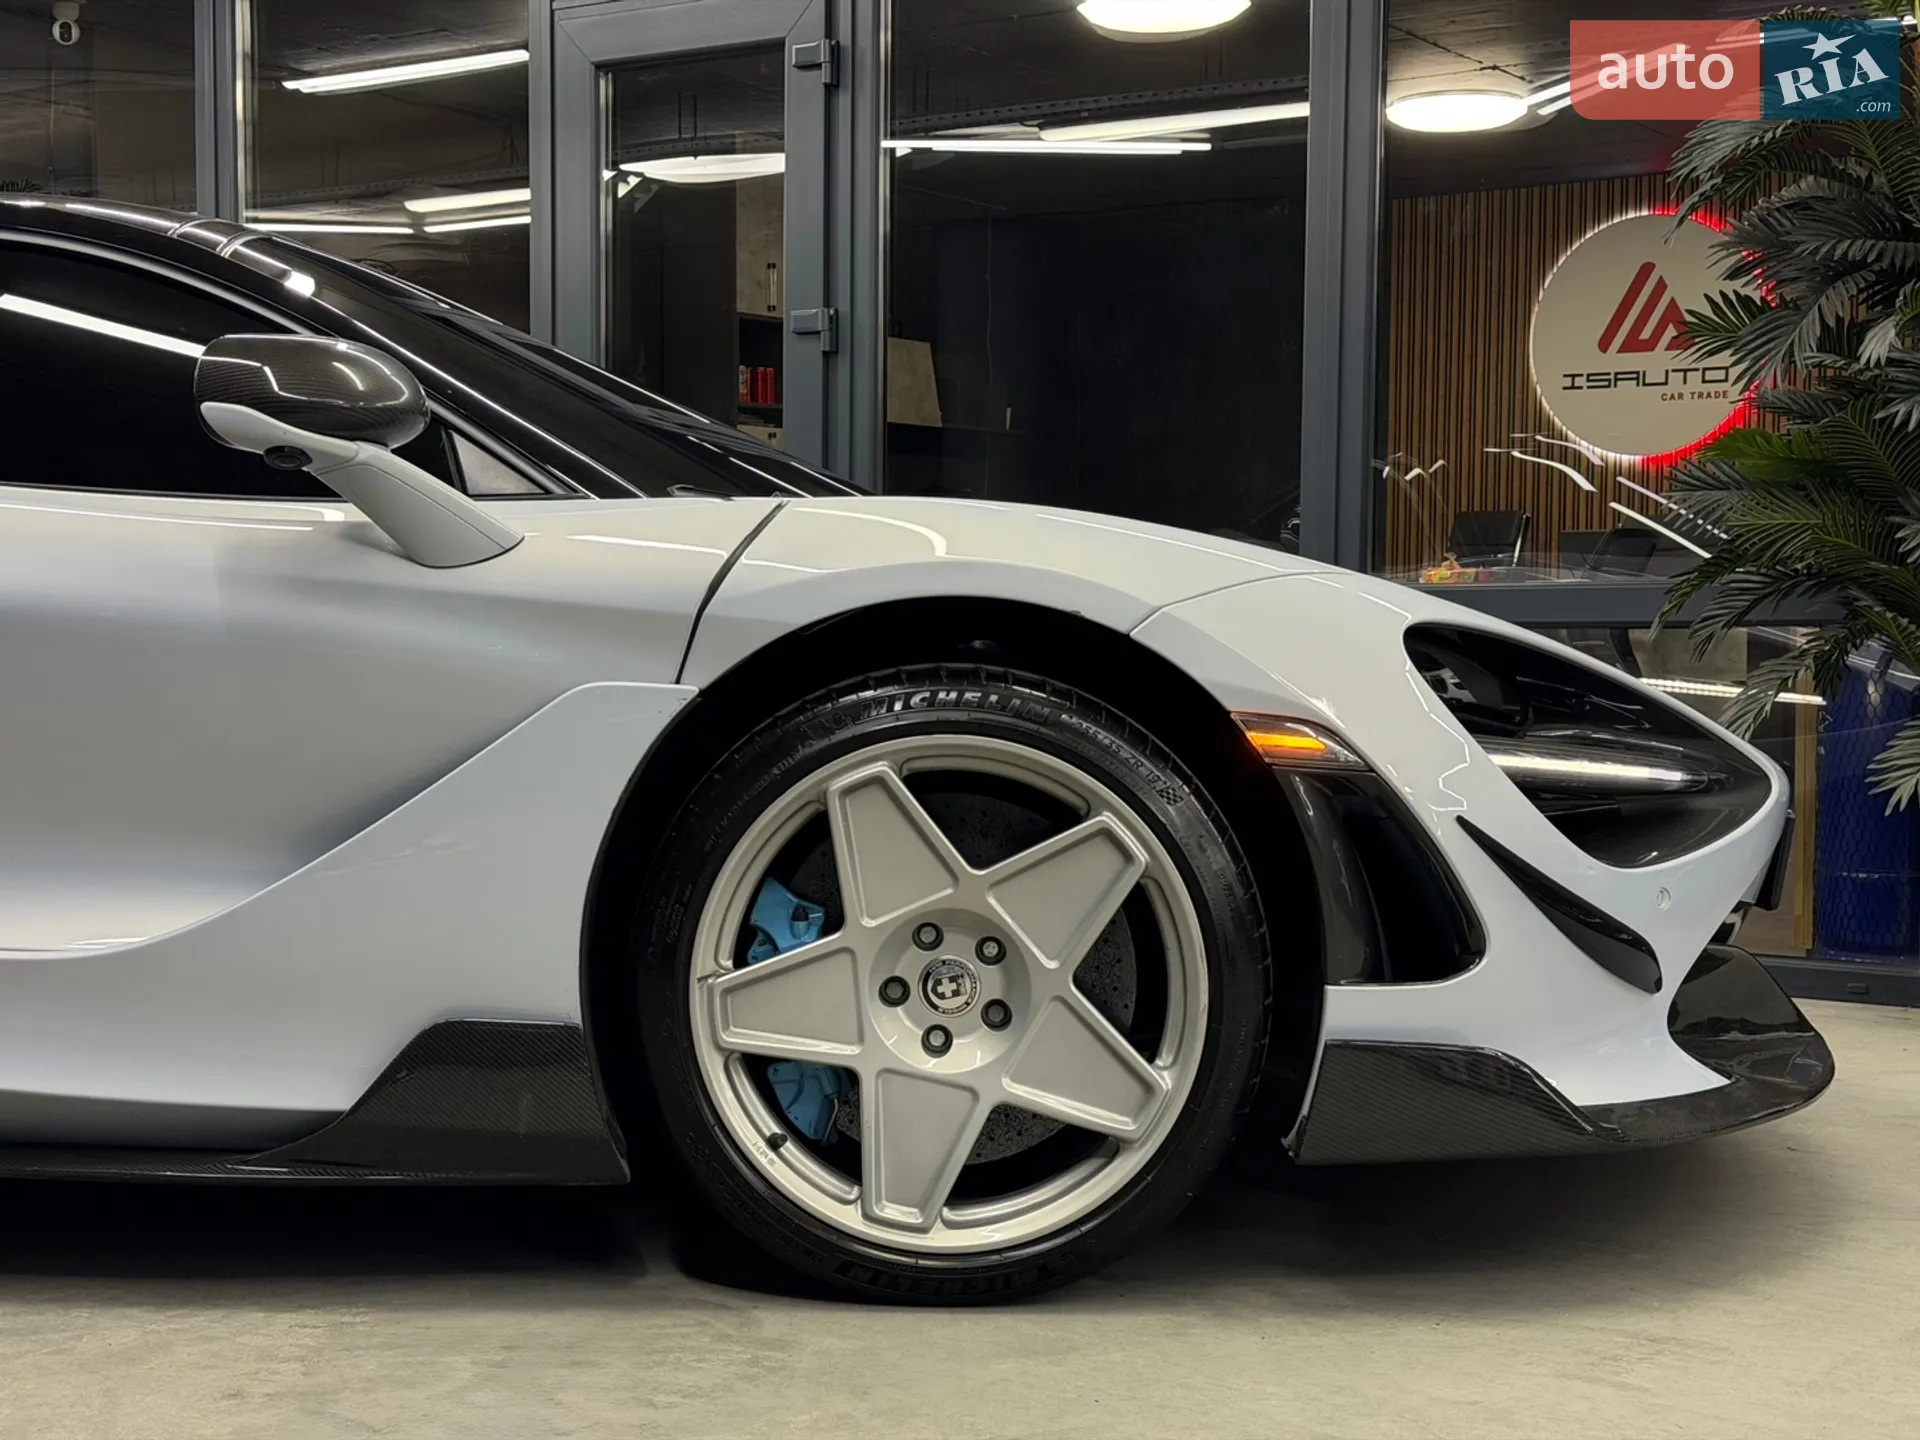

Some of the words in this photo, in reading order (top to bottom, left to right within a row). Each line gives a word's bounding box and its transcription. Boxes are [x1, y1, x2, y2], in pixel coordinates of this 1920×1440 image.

[1561, 366, 1730, 391] ISAUTO
[1660, 392, 1685, 402] CAR
[1689, 390, 1729, 401] TRADE
[860, 689, 1051, 723] MICHELIN
